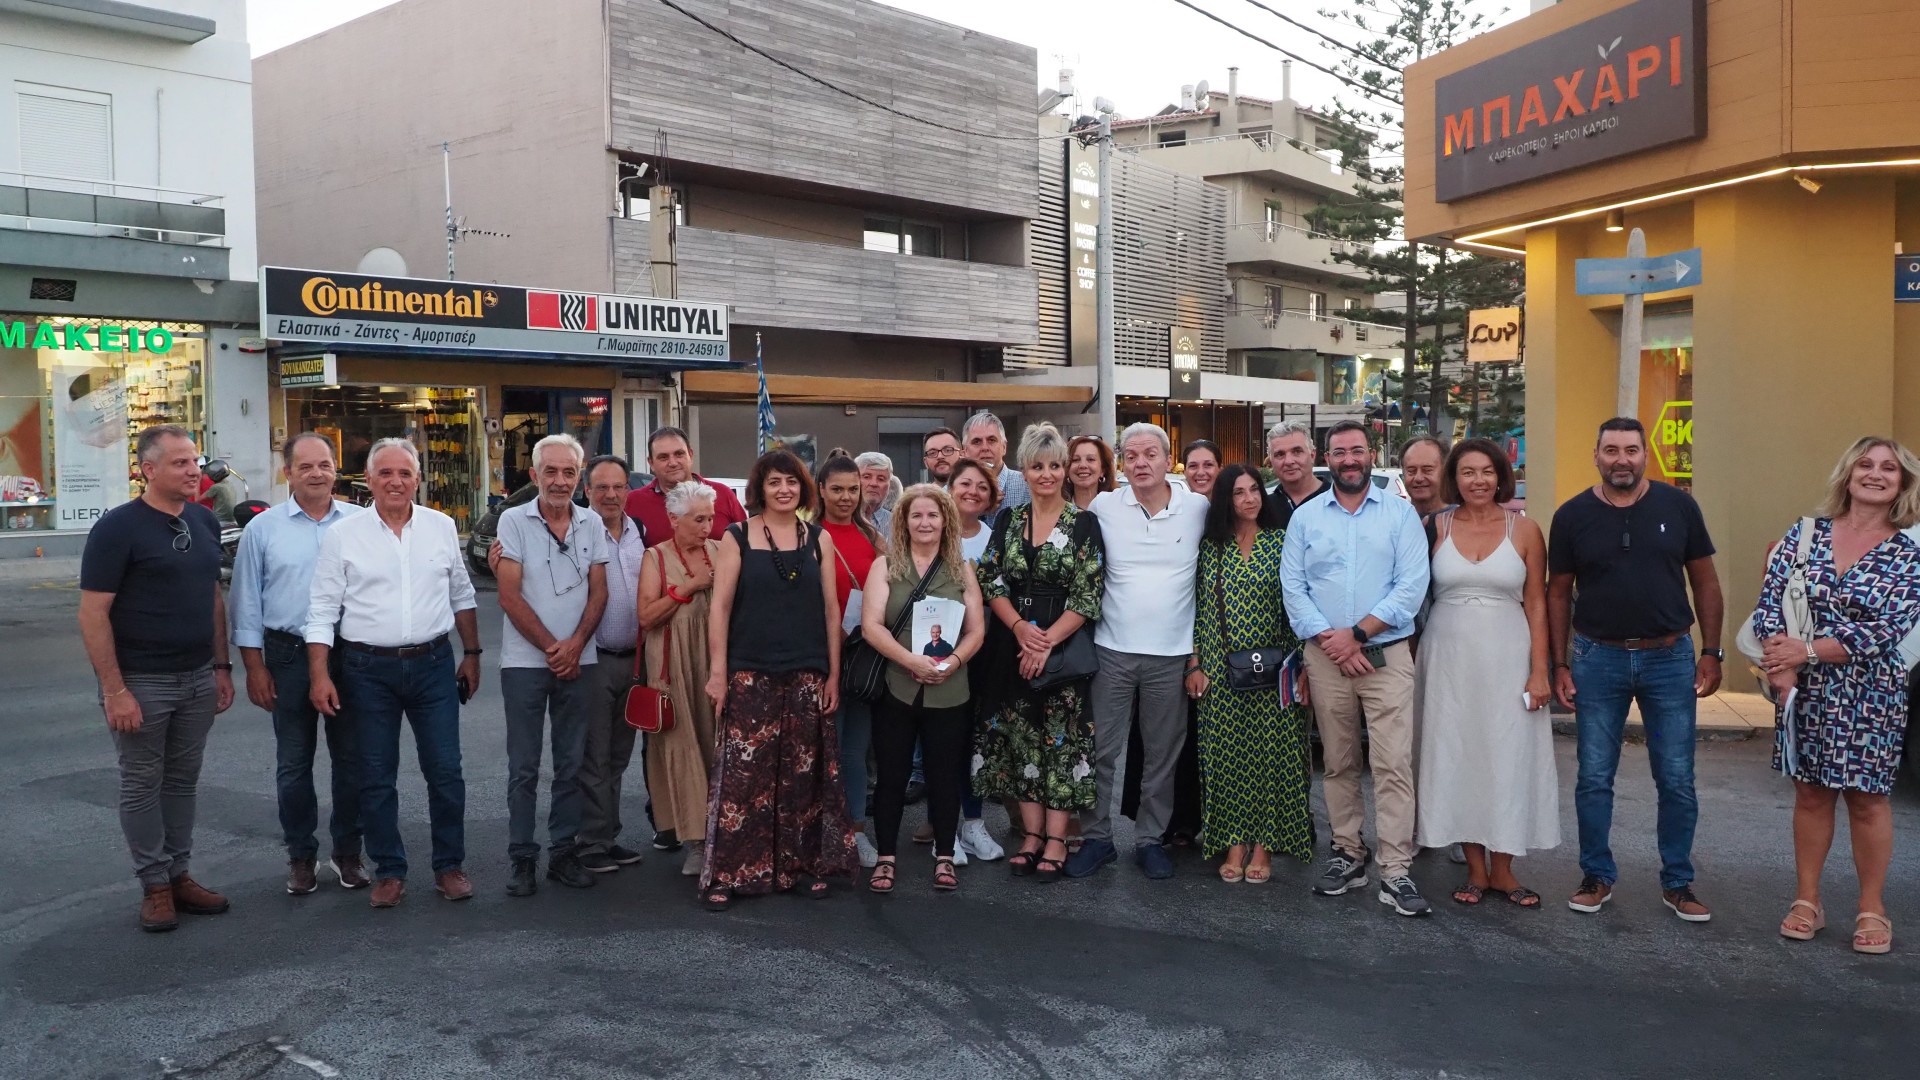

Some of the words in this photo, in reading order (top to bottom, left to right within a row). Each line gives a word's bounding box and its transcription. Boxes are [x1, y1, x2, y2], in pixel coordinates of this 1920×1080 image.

[1443, 35, 1682, 156] ΜΠΑΧΑΡΙ
[302, 277, 483, 318] Continental
[1079, 278, 1095, 290] SHOP
[277, 319, 341, 337] Ελαστικά
[354, 323, 400, 342] Ζάντες
[412, 327, 476, 346] Αμορτισέρ
[605, 301, 723, 335] UNIROYAL
[660, 341, 725, 357] 2810-245913
